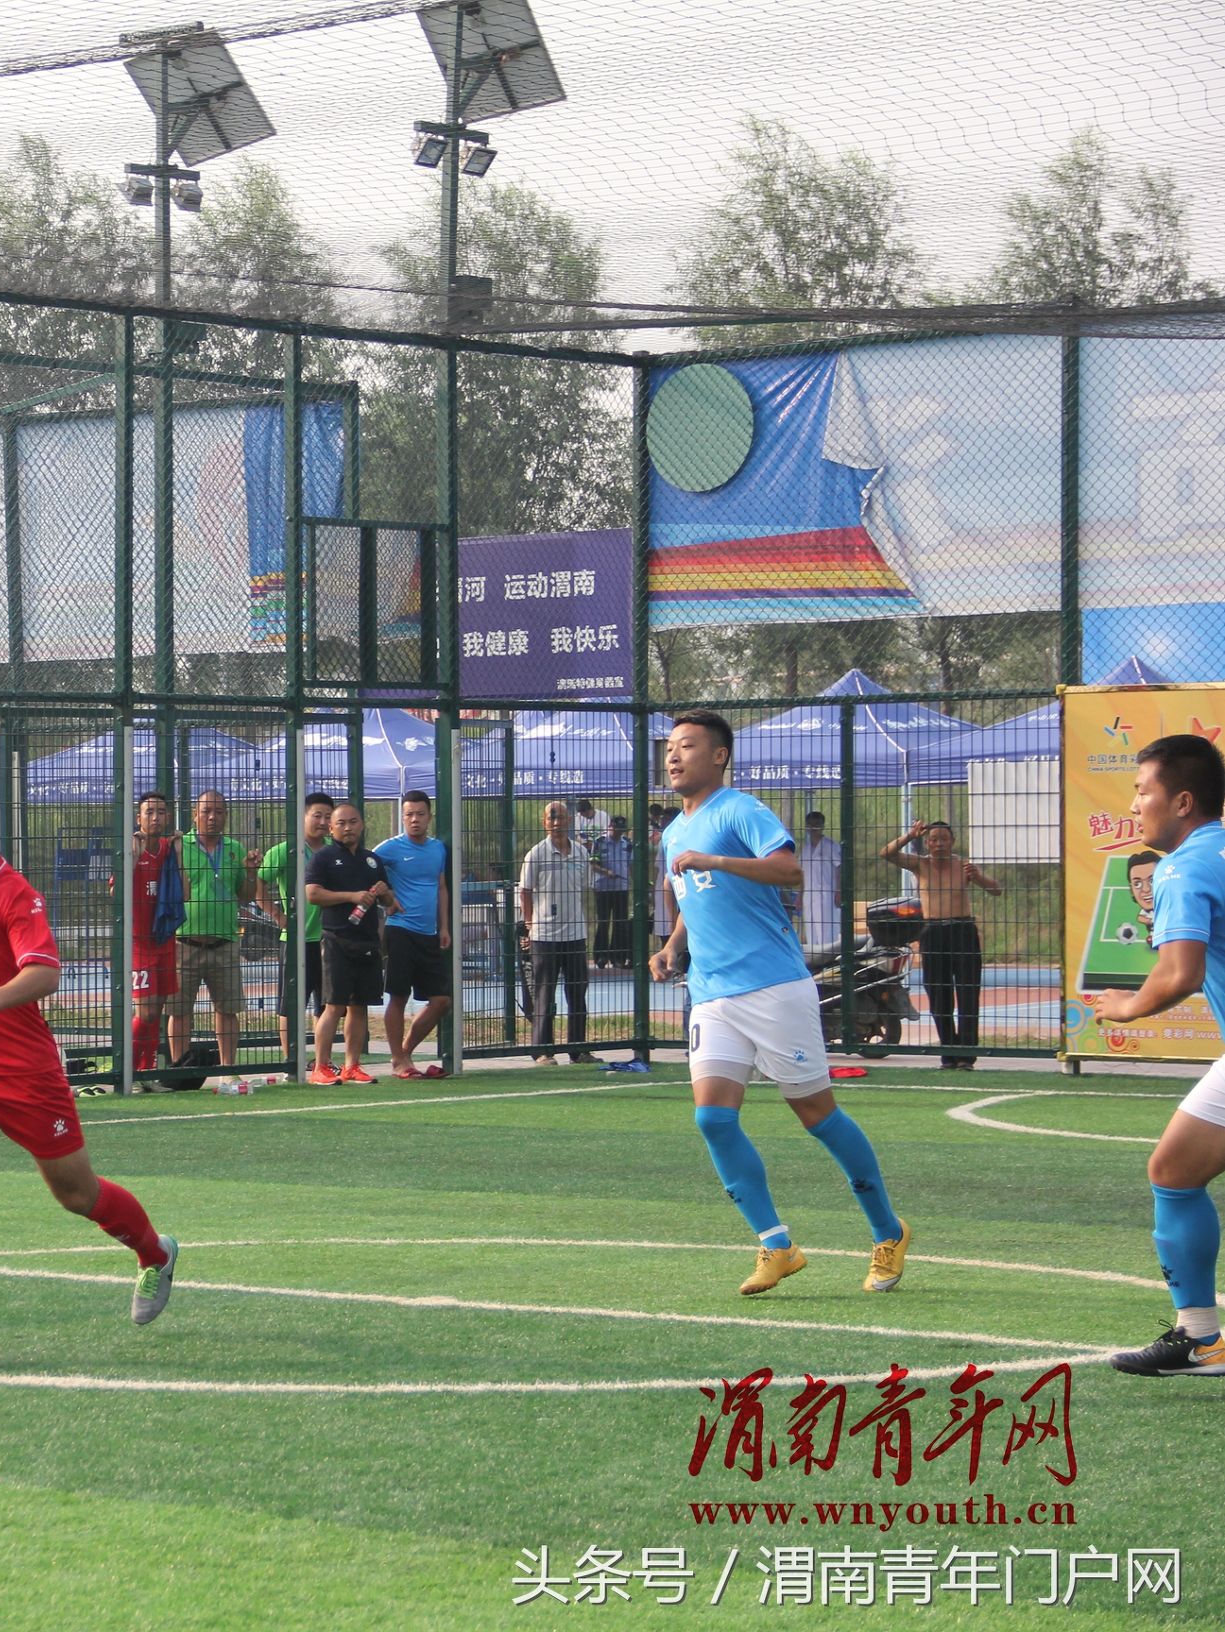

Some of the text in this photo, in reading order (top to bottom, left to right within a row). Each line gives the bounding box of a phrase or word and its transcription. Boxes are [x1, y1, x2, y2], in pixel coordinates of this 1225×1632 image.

[504, 569, 595, 600] 运动渭南
[462, 624, 620, 657] 我健康 我快乐
[131, 969, 150, 991] 22
